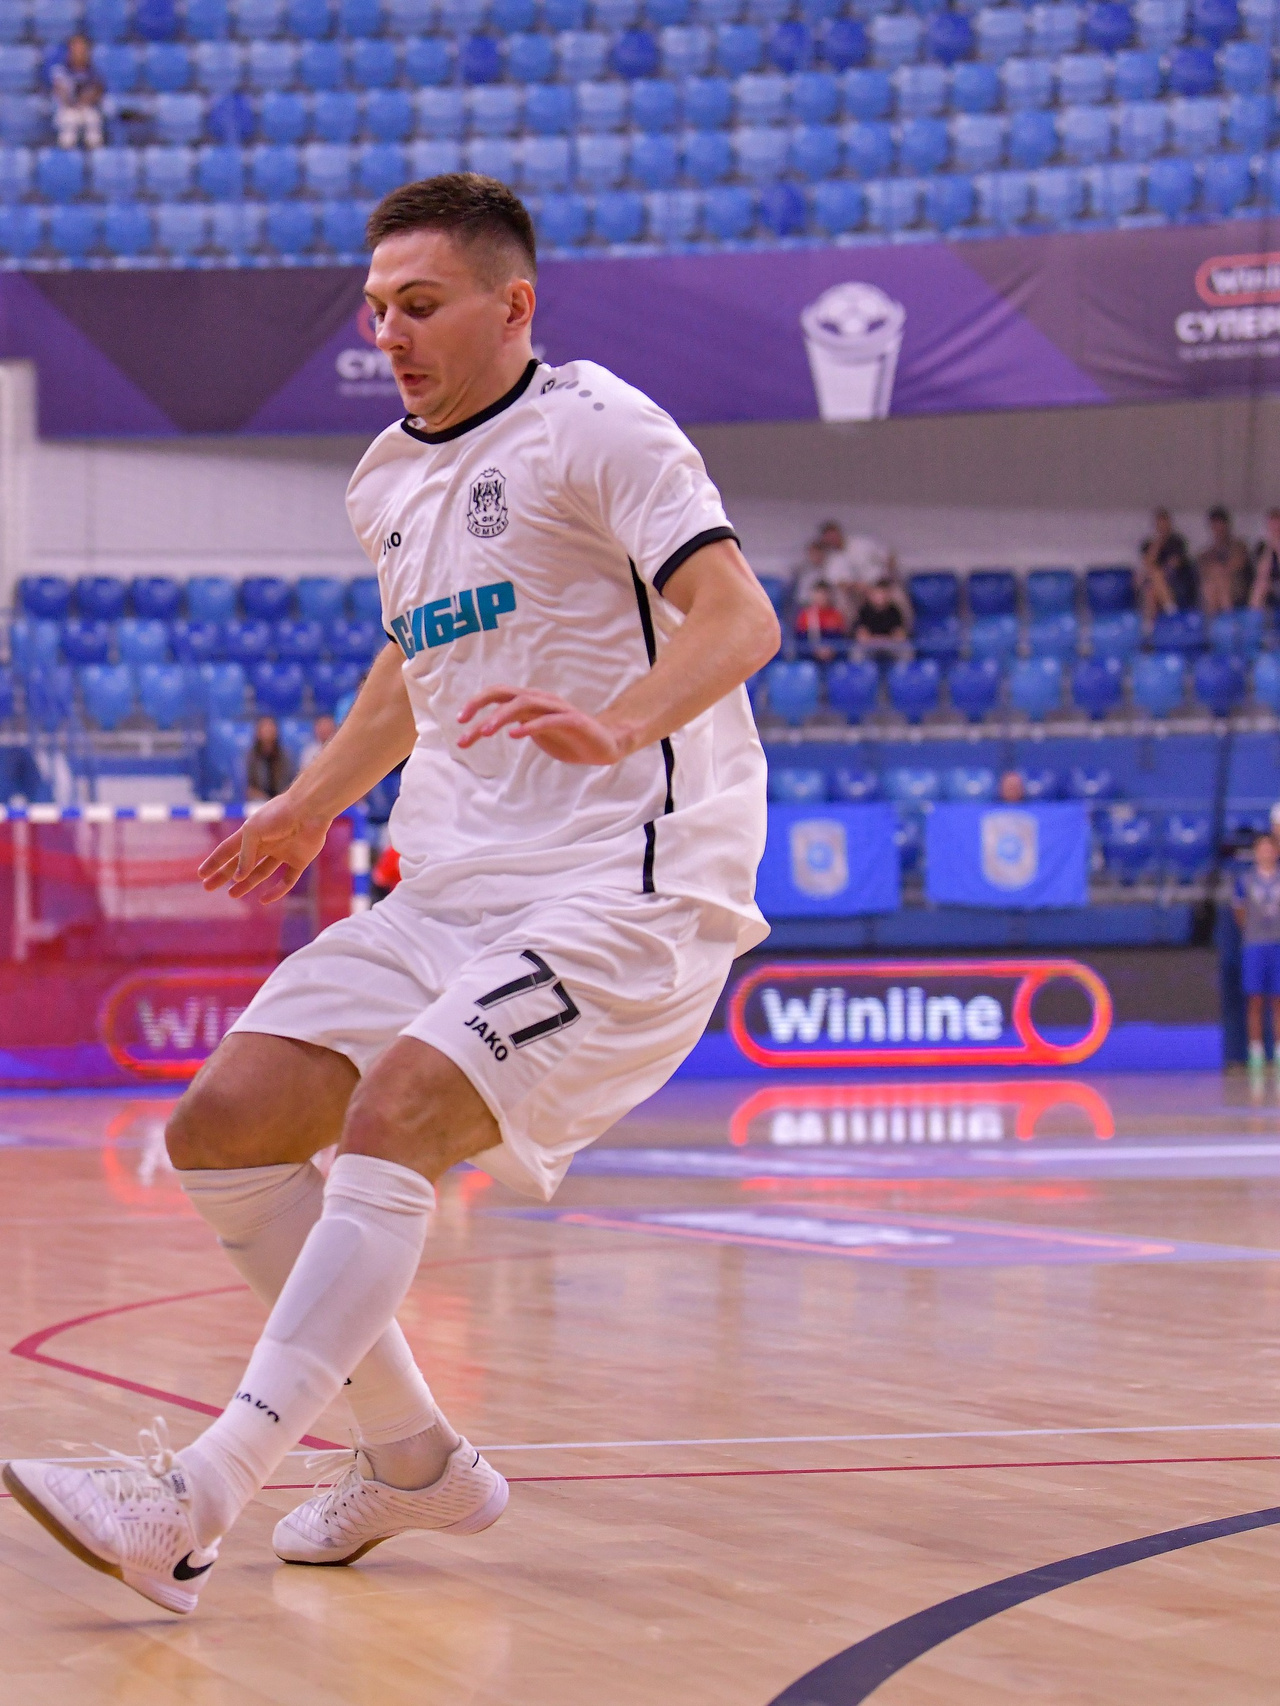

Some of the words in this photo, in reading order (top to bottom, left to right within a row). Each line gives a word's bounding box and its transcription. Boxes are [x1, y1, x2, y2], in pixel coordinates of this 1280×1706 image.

[474, 949, 581, 1050] 77
[762, 986, 1004, 1044] Winline
[464, 1015, 508, 1061] JAKO
